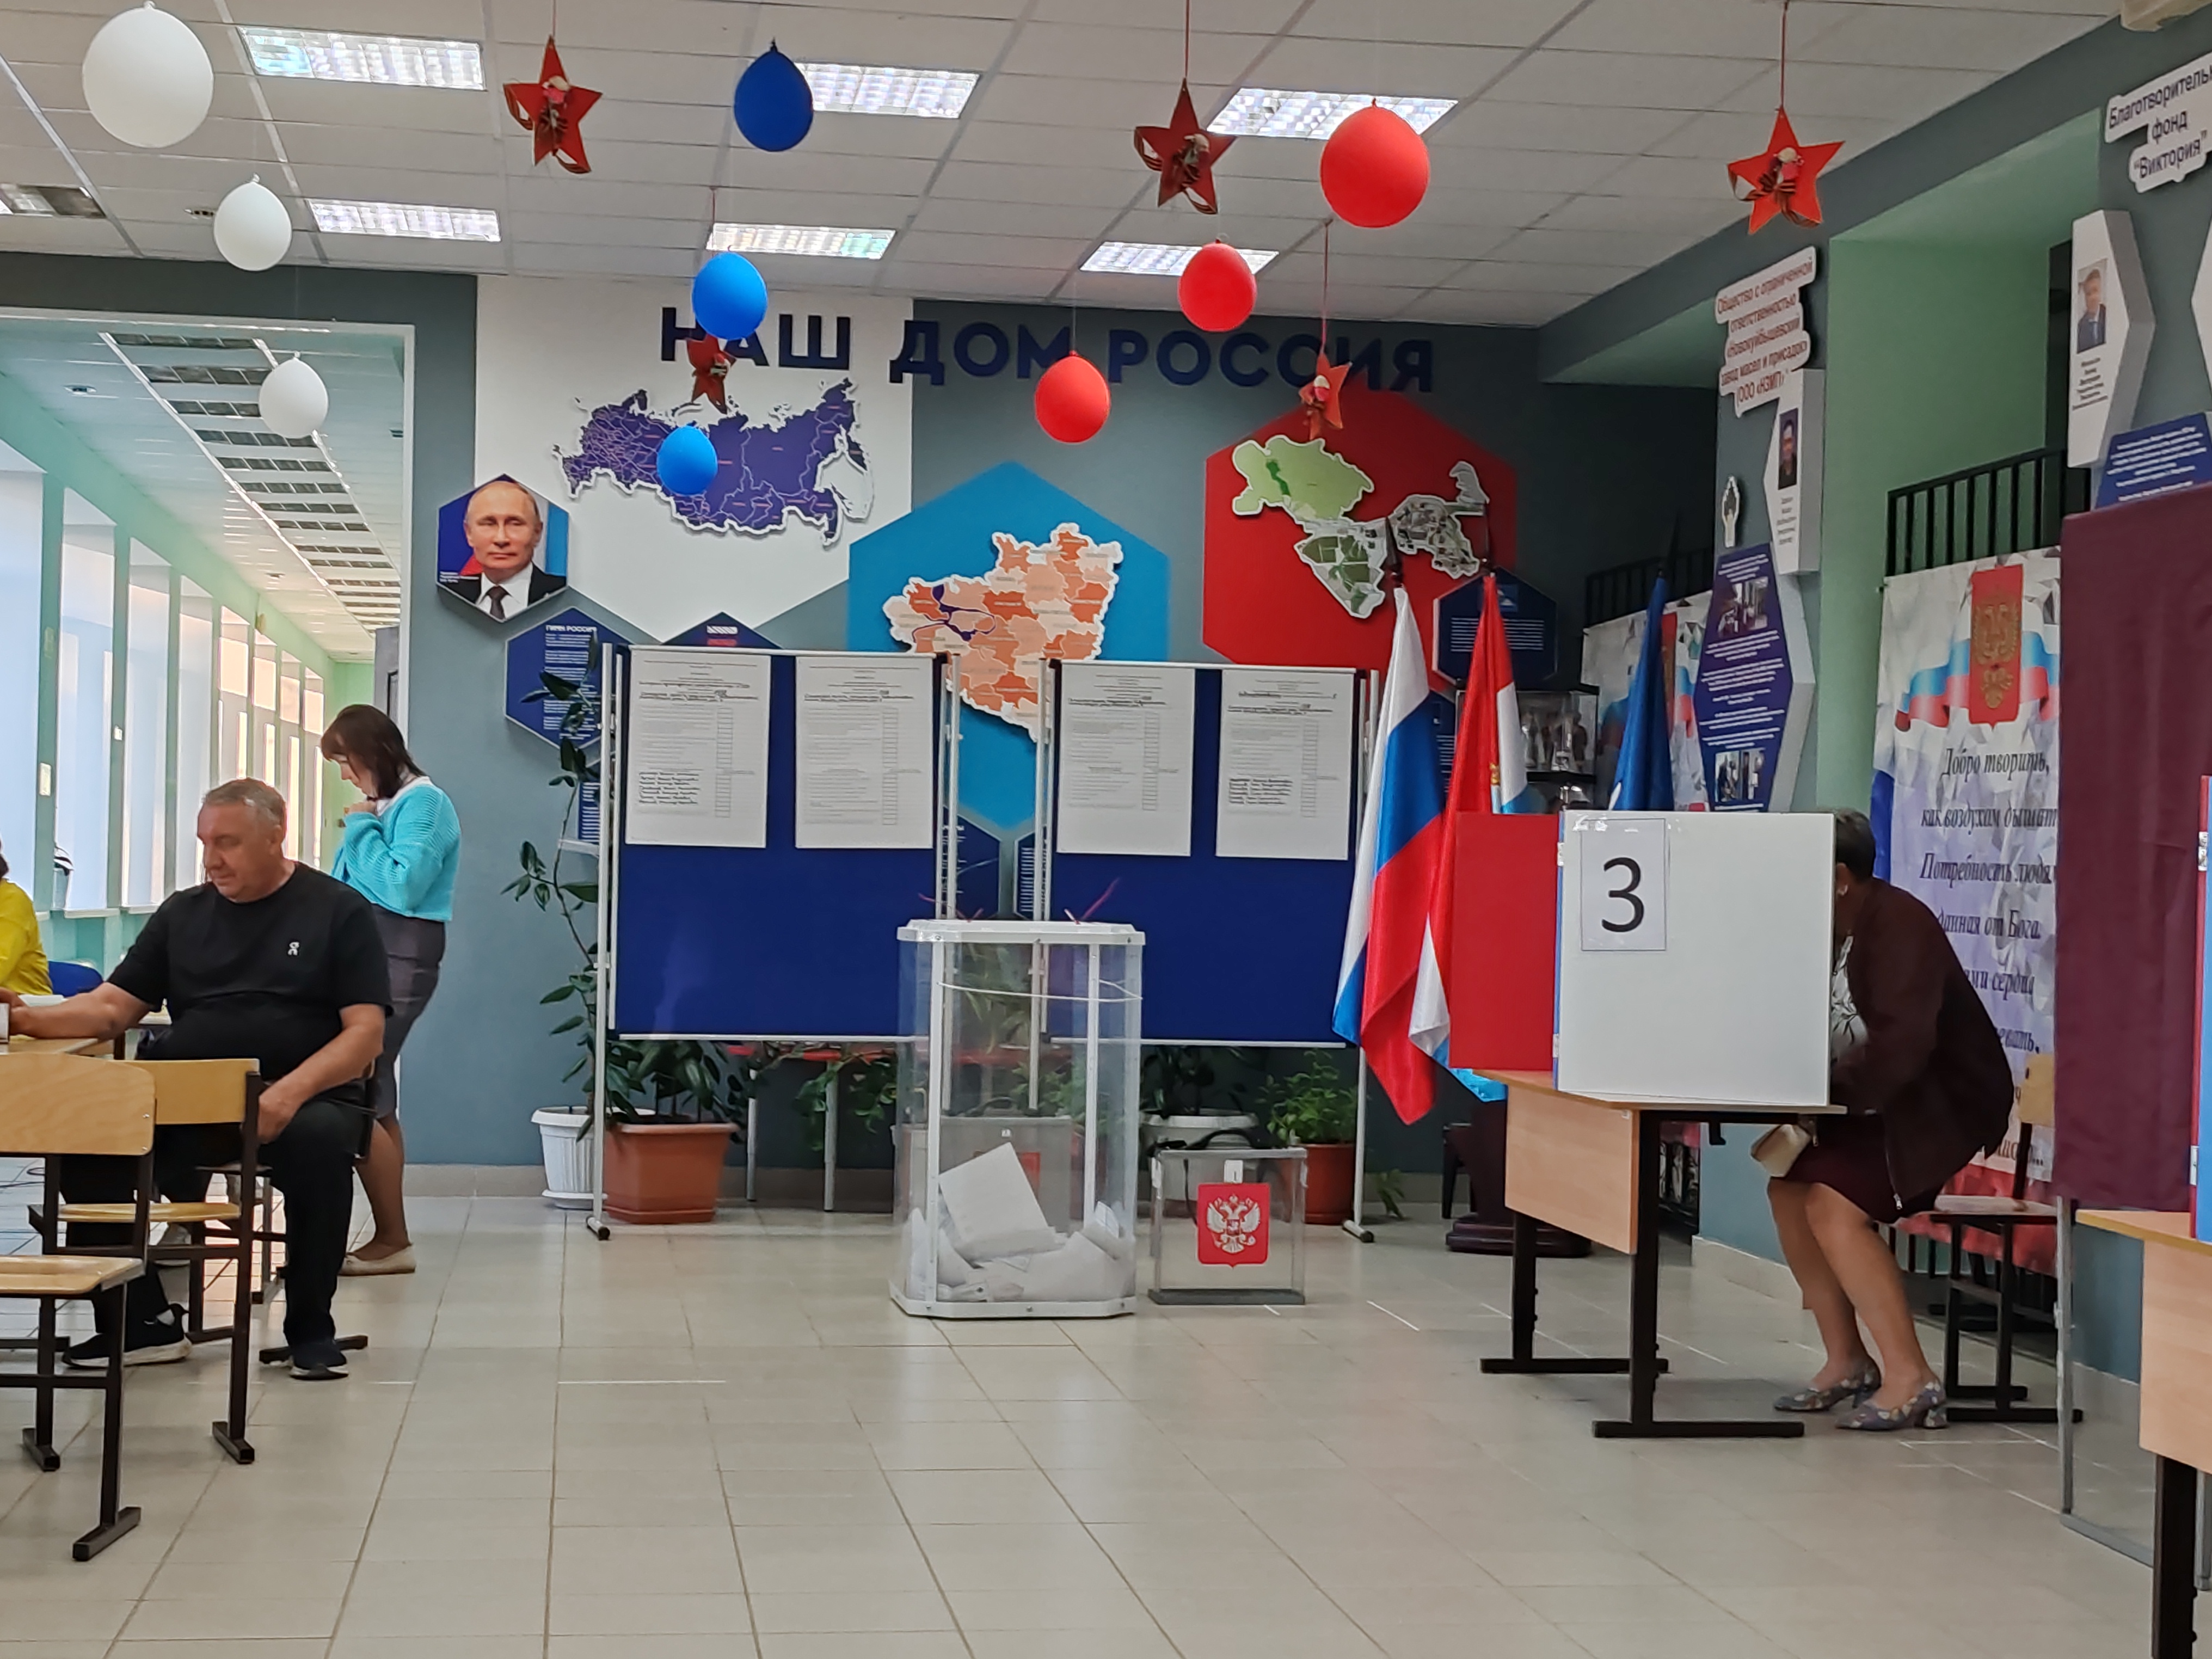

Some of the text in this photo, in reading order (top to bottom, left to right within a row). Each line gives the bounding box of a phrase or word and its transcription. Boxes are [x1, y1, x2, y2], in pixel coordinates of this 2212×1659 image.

[2152, 110, 2188, 145] фонд
[1717, 256, 1813, 314] Общество с ограниченной
[1730, 293, 1796, 333] ответственностью
[661, 307, 1434, 393] НАШ ДОМ РОССИЯ
[1762, 355, 1767, 368] и
[1939, 748, 1981, 783] Добро
[1921, 808, 1942, 827] как
[2004, 799, 2057, 828] дышат
[1919, 852, 2056, 889] Потребность людя
[1601, 857, 1645, 932] 3
[1984, 917, 2004, 936] от
